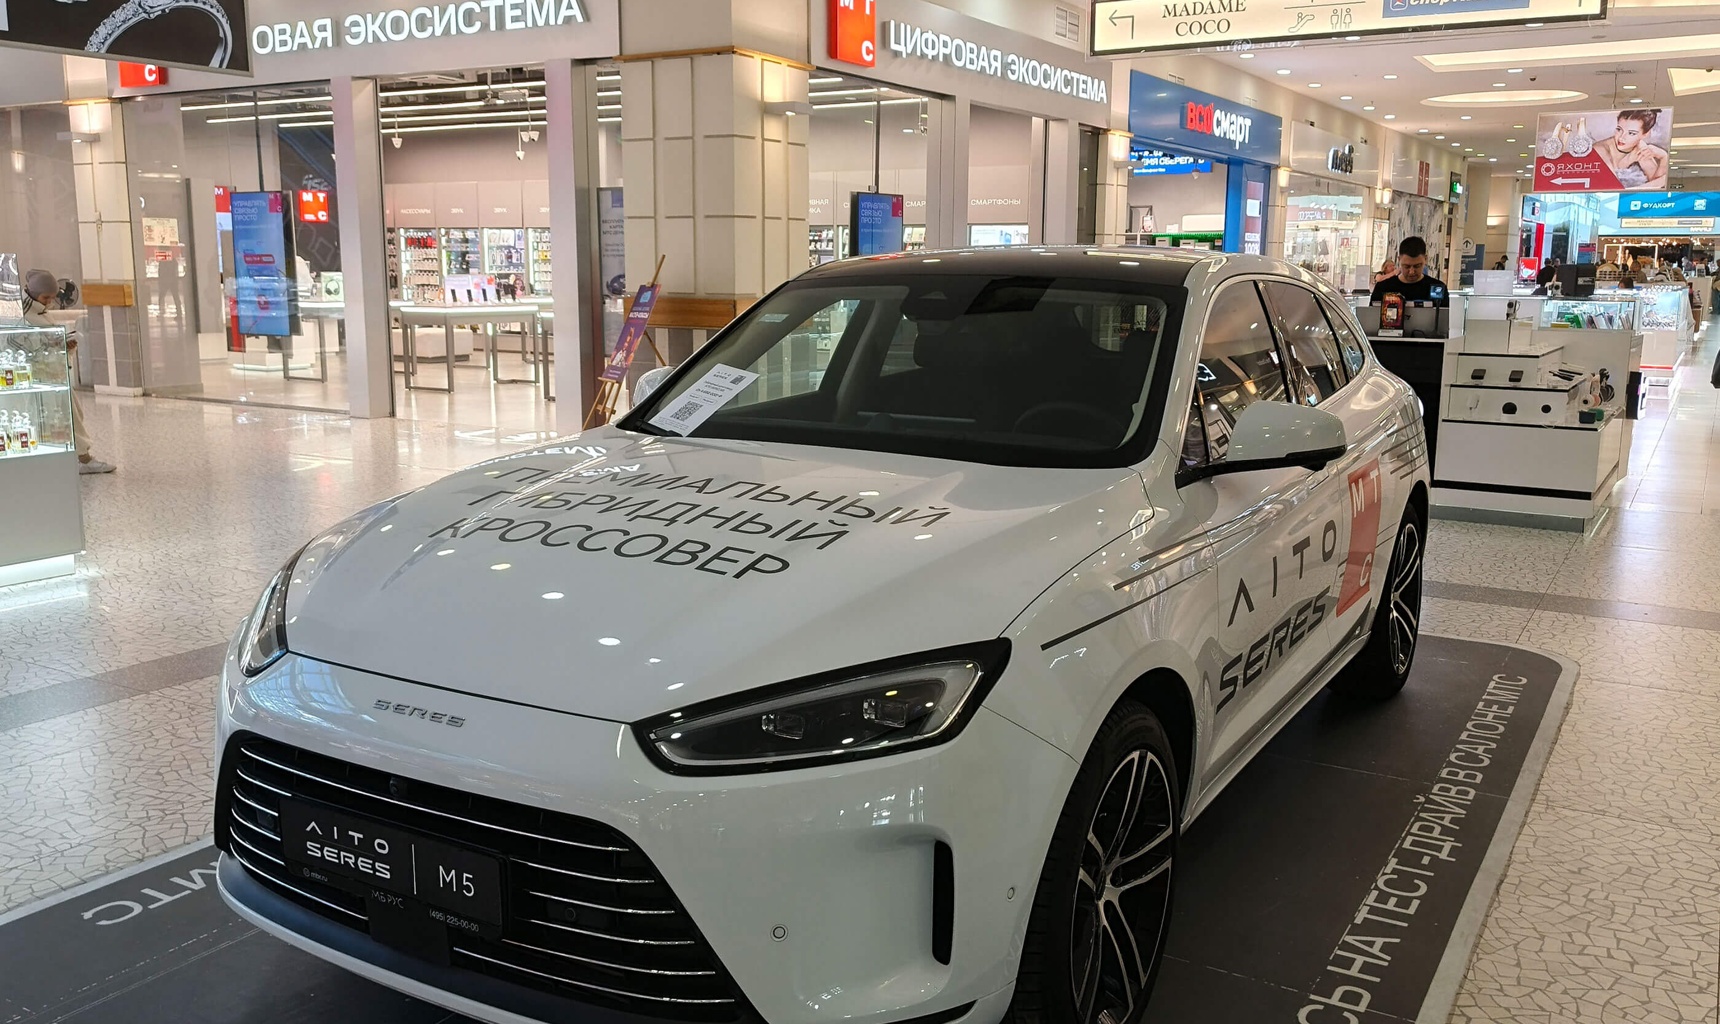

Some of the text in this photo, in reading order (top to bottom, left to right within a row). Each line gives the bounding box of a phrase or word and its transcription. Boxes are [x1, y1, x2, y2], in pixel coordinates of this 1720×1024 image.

[343, 0, 584, 46] ЭКОСИСТЕМА
[1162, 0, 1247, 19] MADAME
[1175, 18, 1231, 37] COCO
[889, 19, 1108, 104] ЦИФРОВАЯ ЭКОСИСТЕМА
[1556, 162, 1601, 170] ЯХОНТ
[860, 209, 883, 217] СВЯЗЬЮ
[970, 198, 1021, 206] СМАРТФОНЫ
[467, 489, 851, 551] ГИБРИДНЫЙ
[428, 513, 791, 580] КРОССОВЕР
[1215, 585, 1331, 716] SERES
[372, 699, 466, 728] SERES
[1448, 701, 1515, 768] САЛОНЕ
[1440, 767, 1483, 784] В
[306, 841, 391, 880] SERES
[1354, 783, 1476, 927] ТЕСТ-ДРАЙВ
[438, 864, 476, 897] M5
[446, 914, 480, 932] 225-00-00
[1327, 934, 1402, 984] НА
